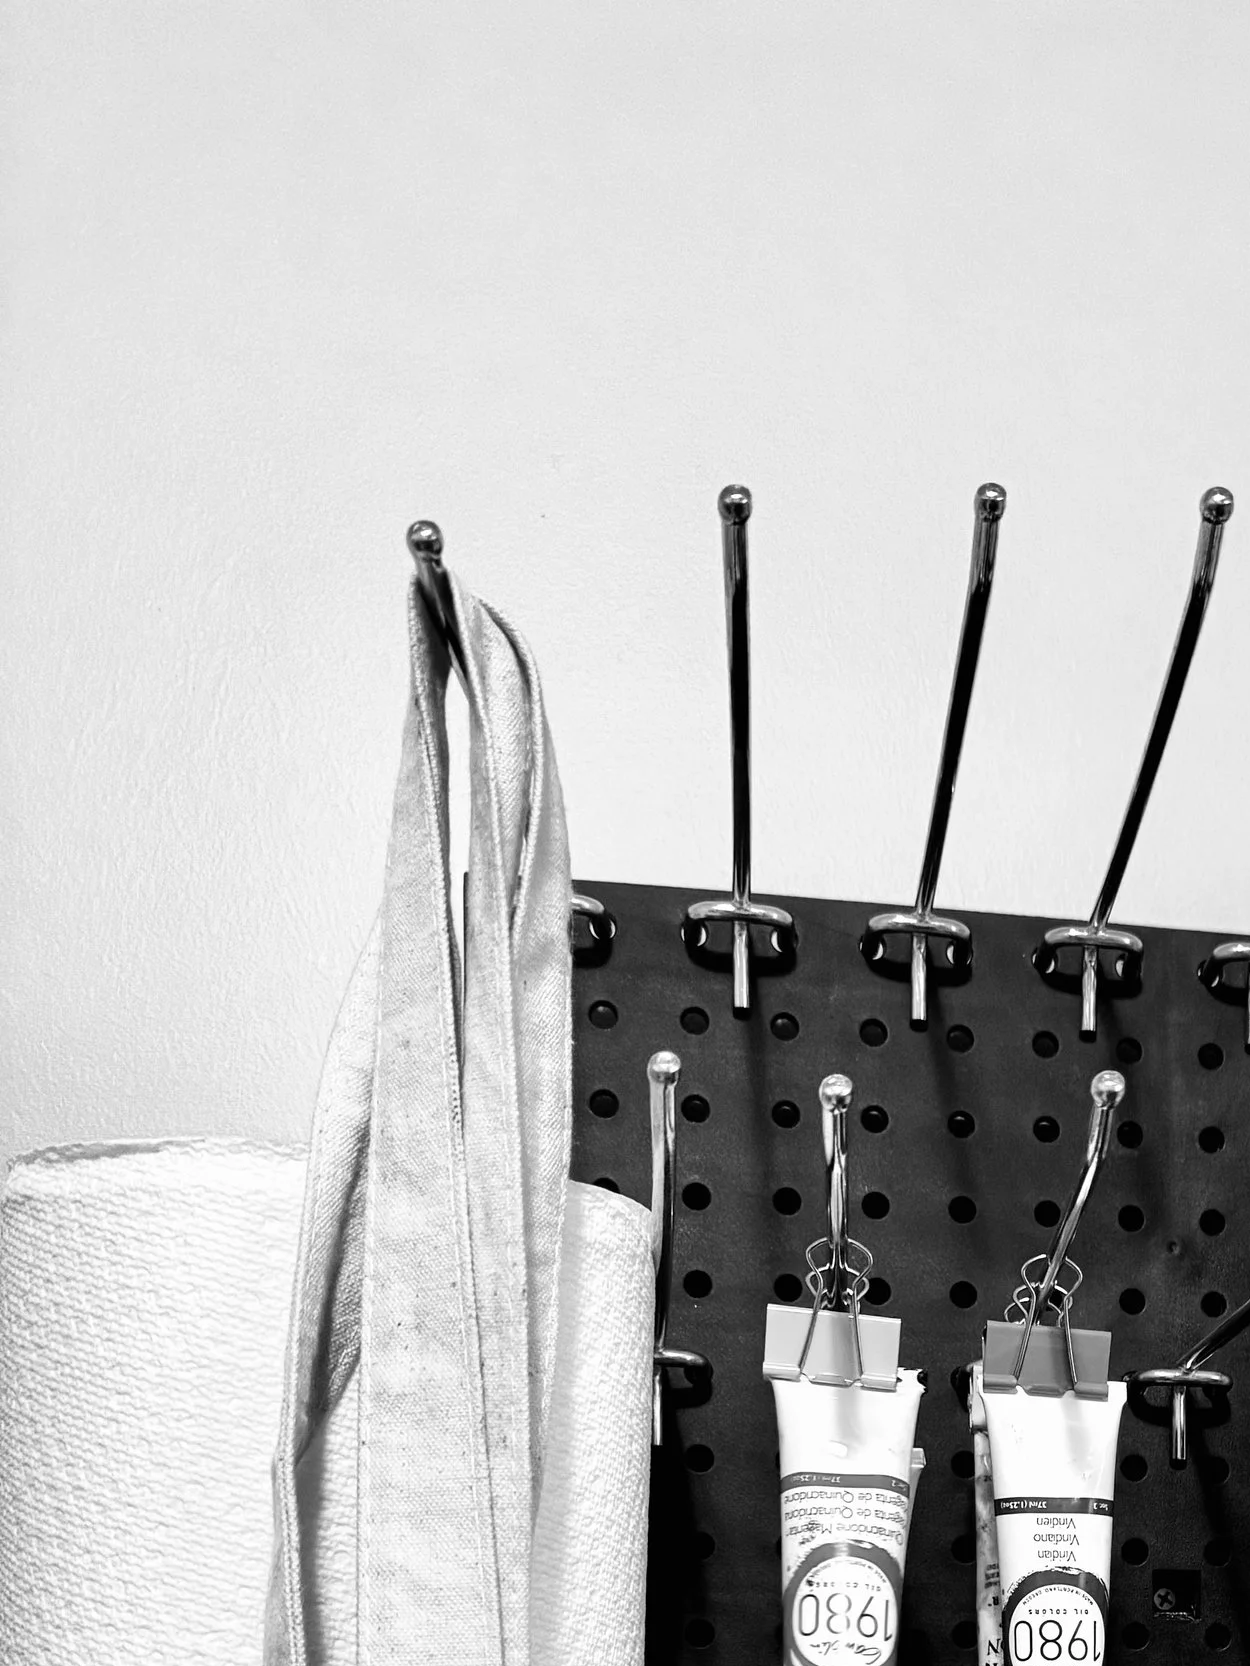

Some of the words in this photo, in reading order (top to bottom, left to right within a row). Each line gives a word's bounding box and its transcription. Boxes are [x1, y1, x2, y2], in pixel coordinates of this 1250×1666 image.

[798, 1592, 893, 1643] 1980
[1028, 1608, 1068, 1616] COLORS
[1073, 1608, 1089, 1616] OIL
[1013, 1619, 1102, 1663] 1980
